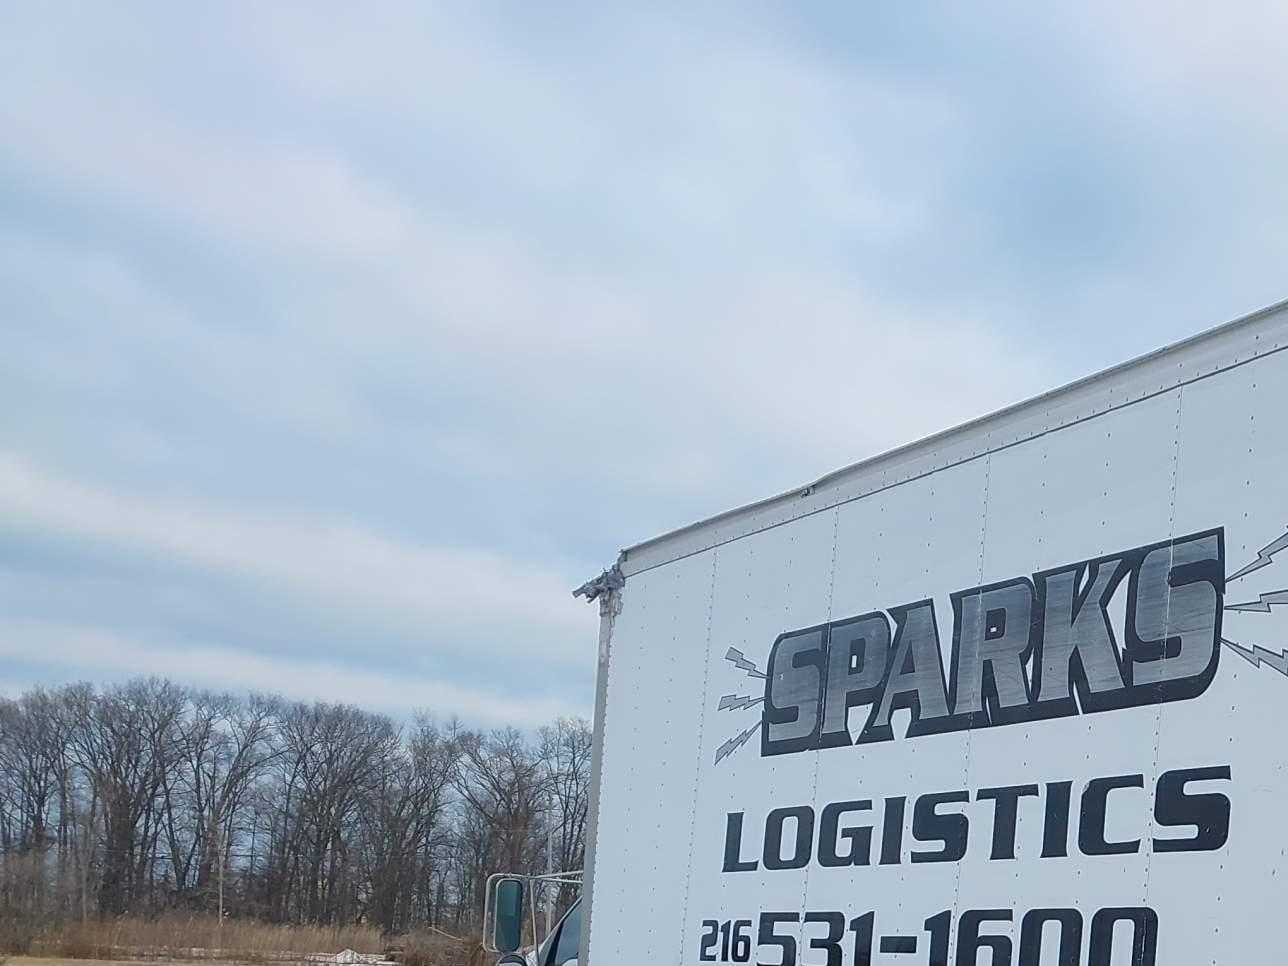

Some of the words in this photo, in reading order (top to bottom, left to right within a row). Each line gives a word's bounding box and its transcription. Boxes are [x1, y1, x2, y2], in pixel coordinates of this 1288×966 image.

[761, 526, 1225, 756] SPARKS
[722, 766, 1231, 873] LOGISTICS
[700, 919, 752, 963] 216
